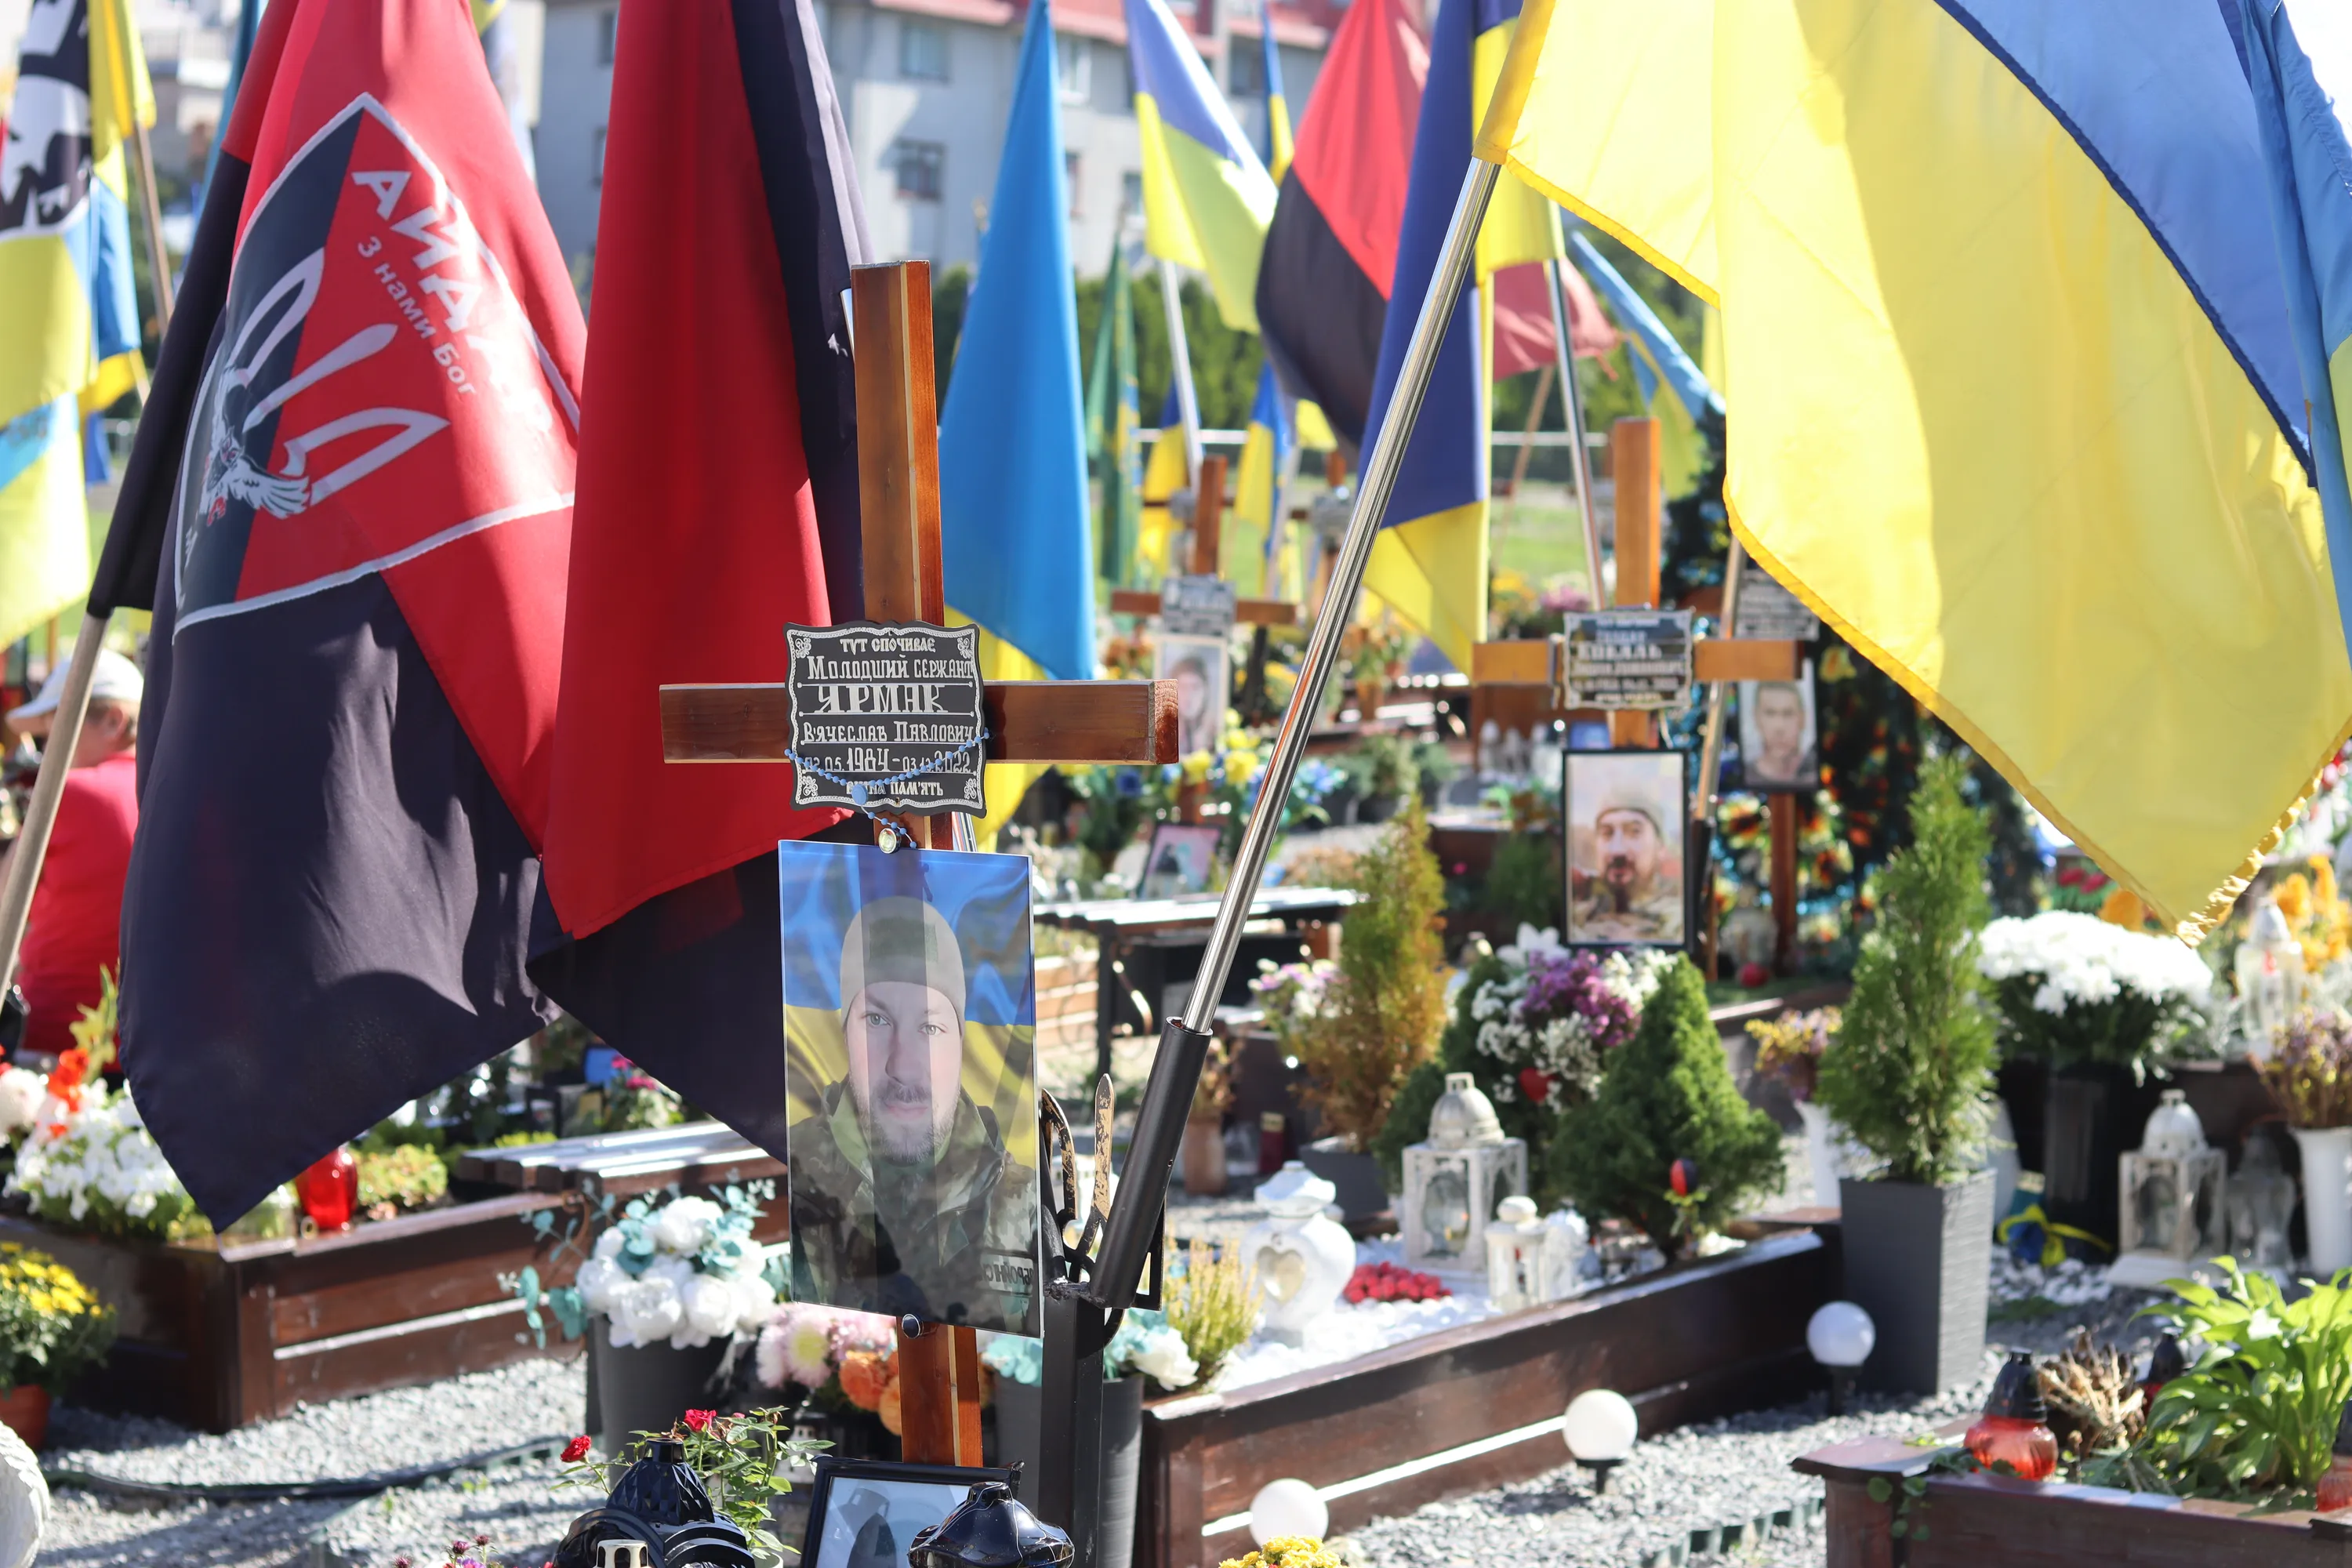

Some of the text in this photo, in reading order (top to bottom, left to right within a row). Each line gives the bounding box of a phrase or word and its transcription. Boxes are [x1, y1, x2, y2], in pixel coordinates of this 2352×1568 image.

[358, 236, 477, 394] З нами Бог
[814, 684, 948, 713] ЯРМАК
